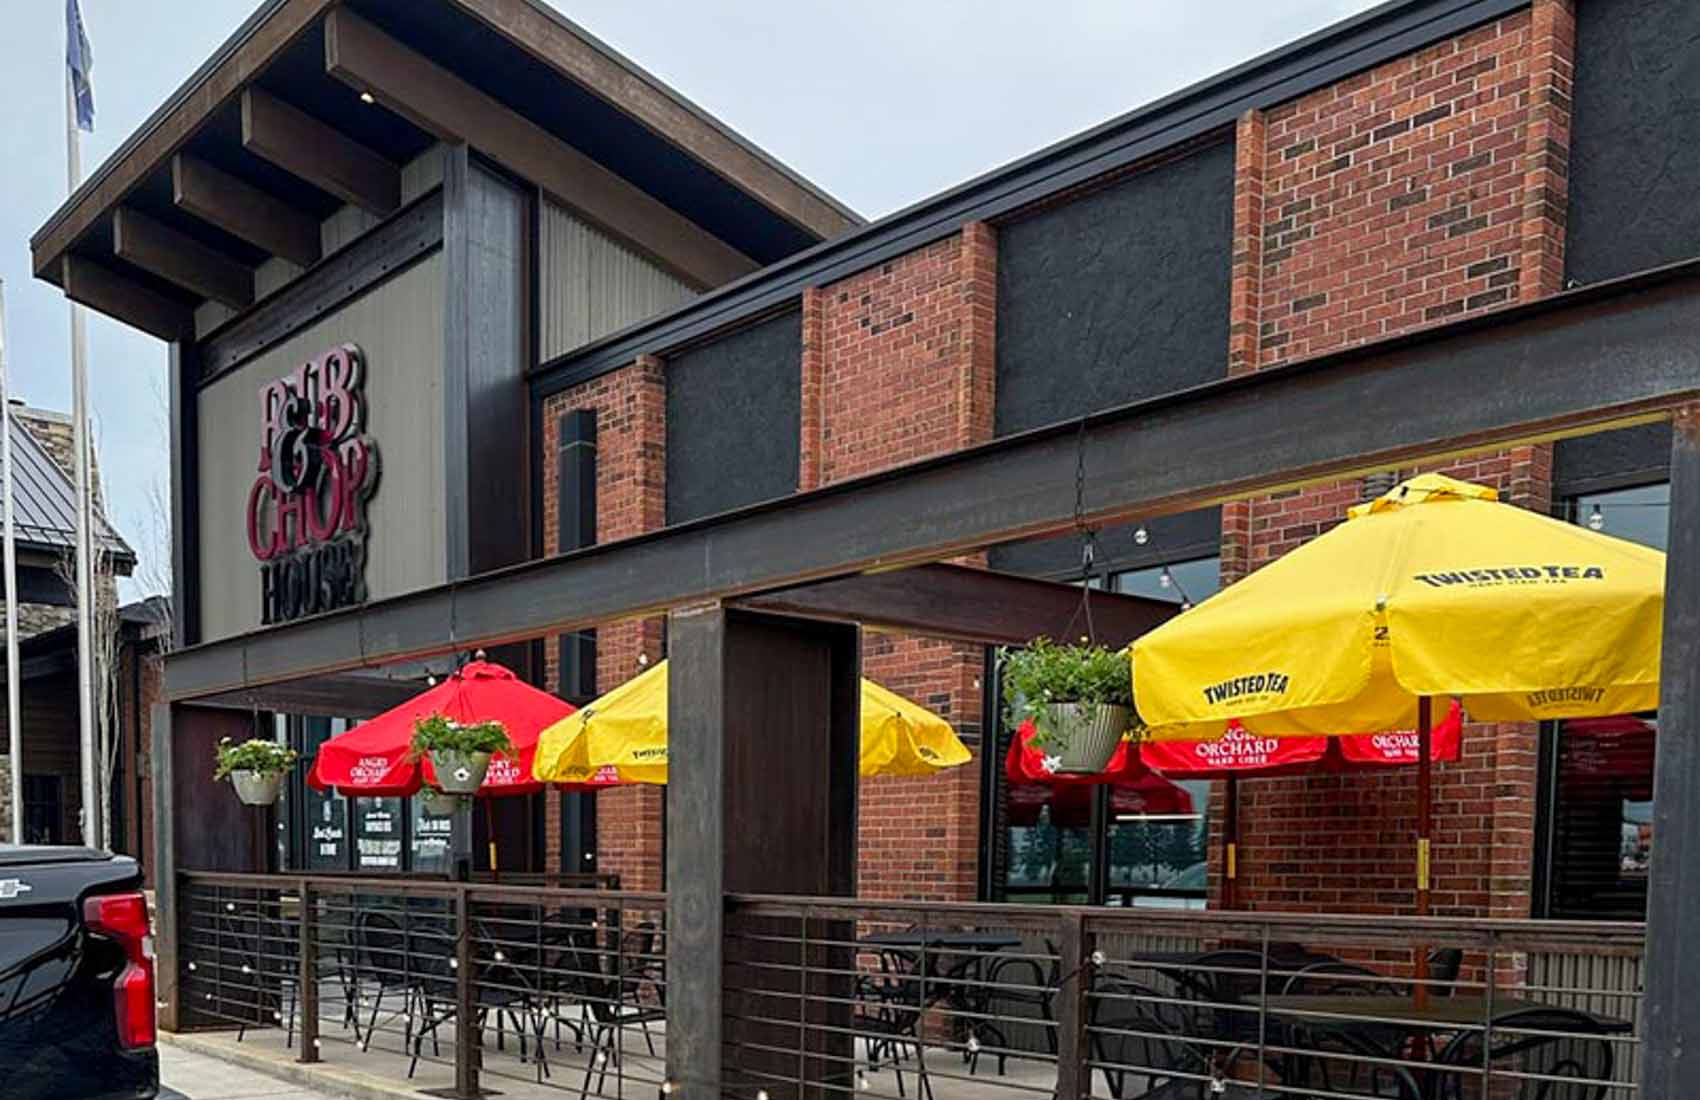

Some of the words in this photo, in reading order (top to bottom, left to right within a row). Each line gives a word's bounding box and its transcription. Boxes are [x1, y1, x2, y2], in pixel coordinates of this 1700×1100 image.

[247, 440, 371, 562] CHOP
[261, 542, 360, 625] HOUSE
[1413, 567, 1542, 588] TWISTED
[1542, 565, 1605, 580] TEA
[1203, 675, 1266, 705] TWISTED
[1265, 672, 1289, 695] TEA
[1195, 738, 1279, 757] ORCHARD
[1371, 735, 1420, 749] ORCHAR
